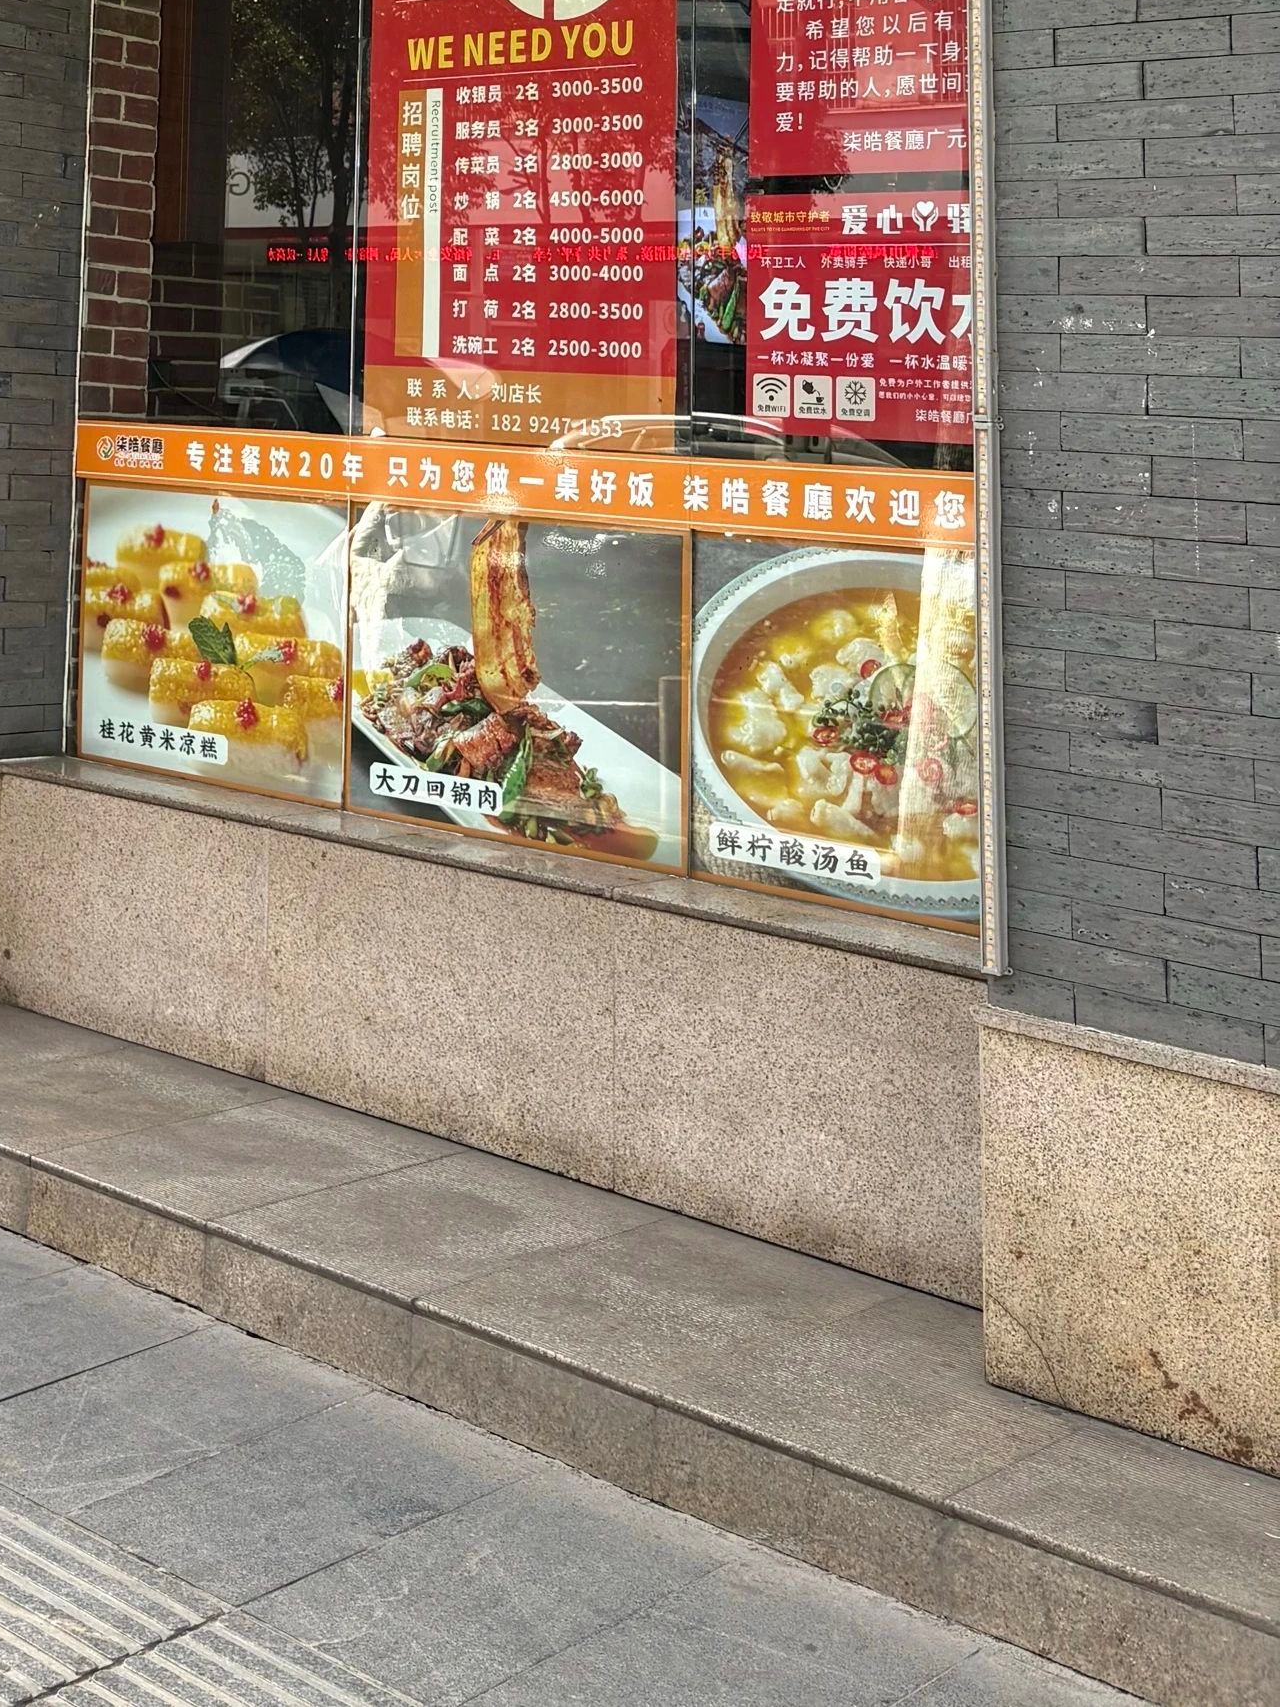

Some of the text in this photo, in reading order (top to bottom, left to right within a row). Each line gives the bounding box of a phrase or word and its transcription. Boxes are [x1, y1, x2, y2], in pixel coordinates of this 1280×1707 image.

[805, 9, 968, 41] 希望您以后有
[407, 20, 634, 71] WE NEED YOU
[776, 40, 968, 74] 力，记得帮助一下身
[456, 76, 643, 105] 收银员 2名 3000-3500
[776, 72, 968, 104] 要帮助的人，愿世间
[455, 114, 643, 141] 服务员 3名 3000-3500
[400, 100, 423, 221] 招聘岗位
[428, 100, 441, 214] Recruitment post
[454, 151, 643, 176] 传菜员 3名 2800-3000
[512, 192, 538, 210] 2名
[549, 188, 644, 207] 4500-6000
[750, 210, 830, 224] 致敬城市守护者
[512, 228, 537, 246] 2名
[549, 227, 644, 245] 4000-5000
[512, 264, 537, 282] 2名
[549, 264, 644, 283] 3000-4000
[761, 256, 806, 269] 环卫工人
[821, 256, 868, 269] 外卖骑手
[883, 256, 932, 270] 快递小哥
[511, 301, 536, 320] 2名
[548, 302, 643, 320] 2800-3500
[452, 335, 642, 359] 洗碗工 2名 2500-3000
[757, 350, 971, 372] 一杯水凝聚一份爱 一杯水温暖
[491, 382, 542, 404] 刘店长
[879, 377, 972, 390] 免费为户外工作者提供
[491, 414, 521, 432] 182
[529, 416, 570, 435] 9247
[581, 418, 622, 438] 1553
[185, 440, 365, 485] 专注餐饮20年
[387, 456, 655, 509] 只为您做一桌好饭
[683, 474, 967, 530] 柒皓餐廳欢迎您
[98, 719, 218, 761] 桂花黄米凉糕
[374, 767, 498, 813] 大刀回锅肉
[716, 828, 875, 880] 鲜柠酸汤鱼
